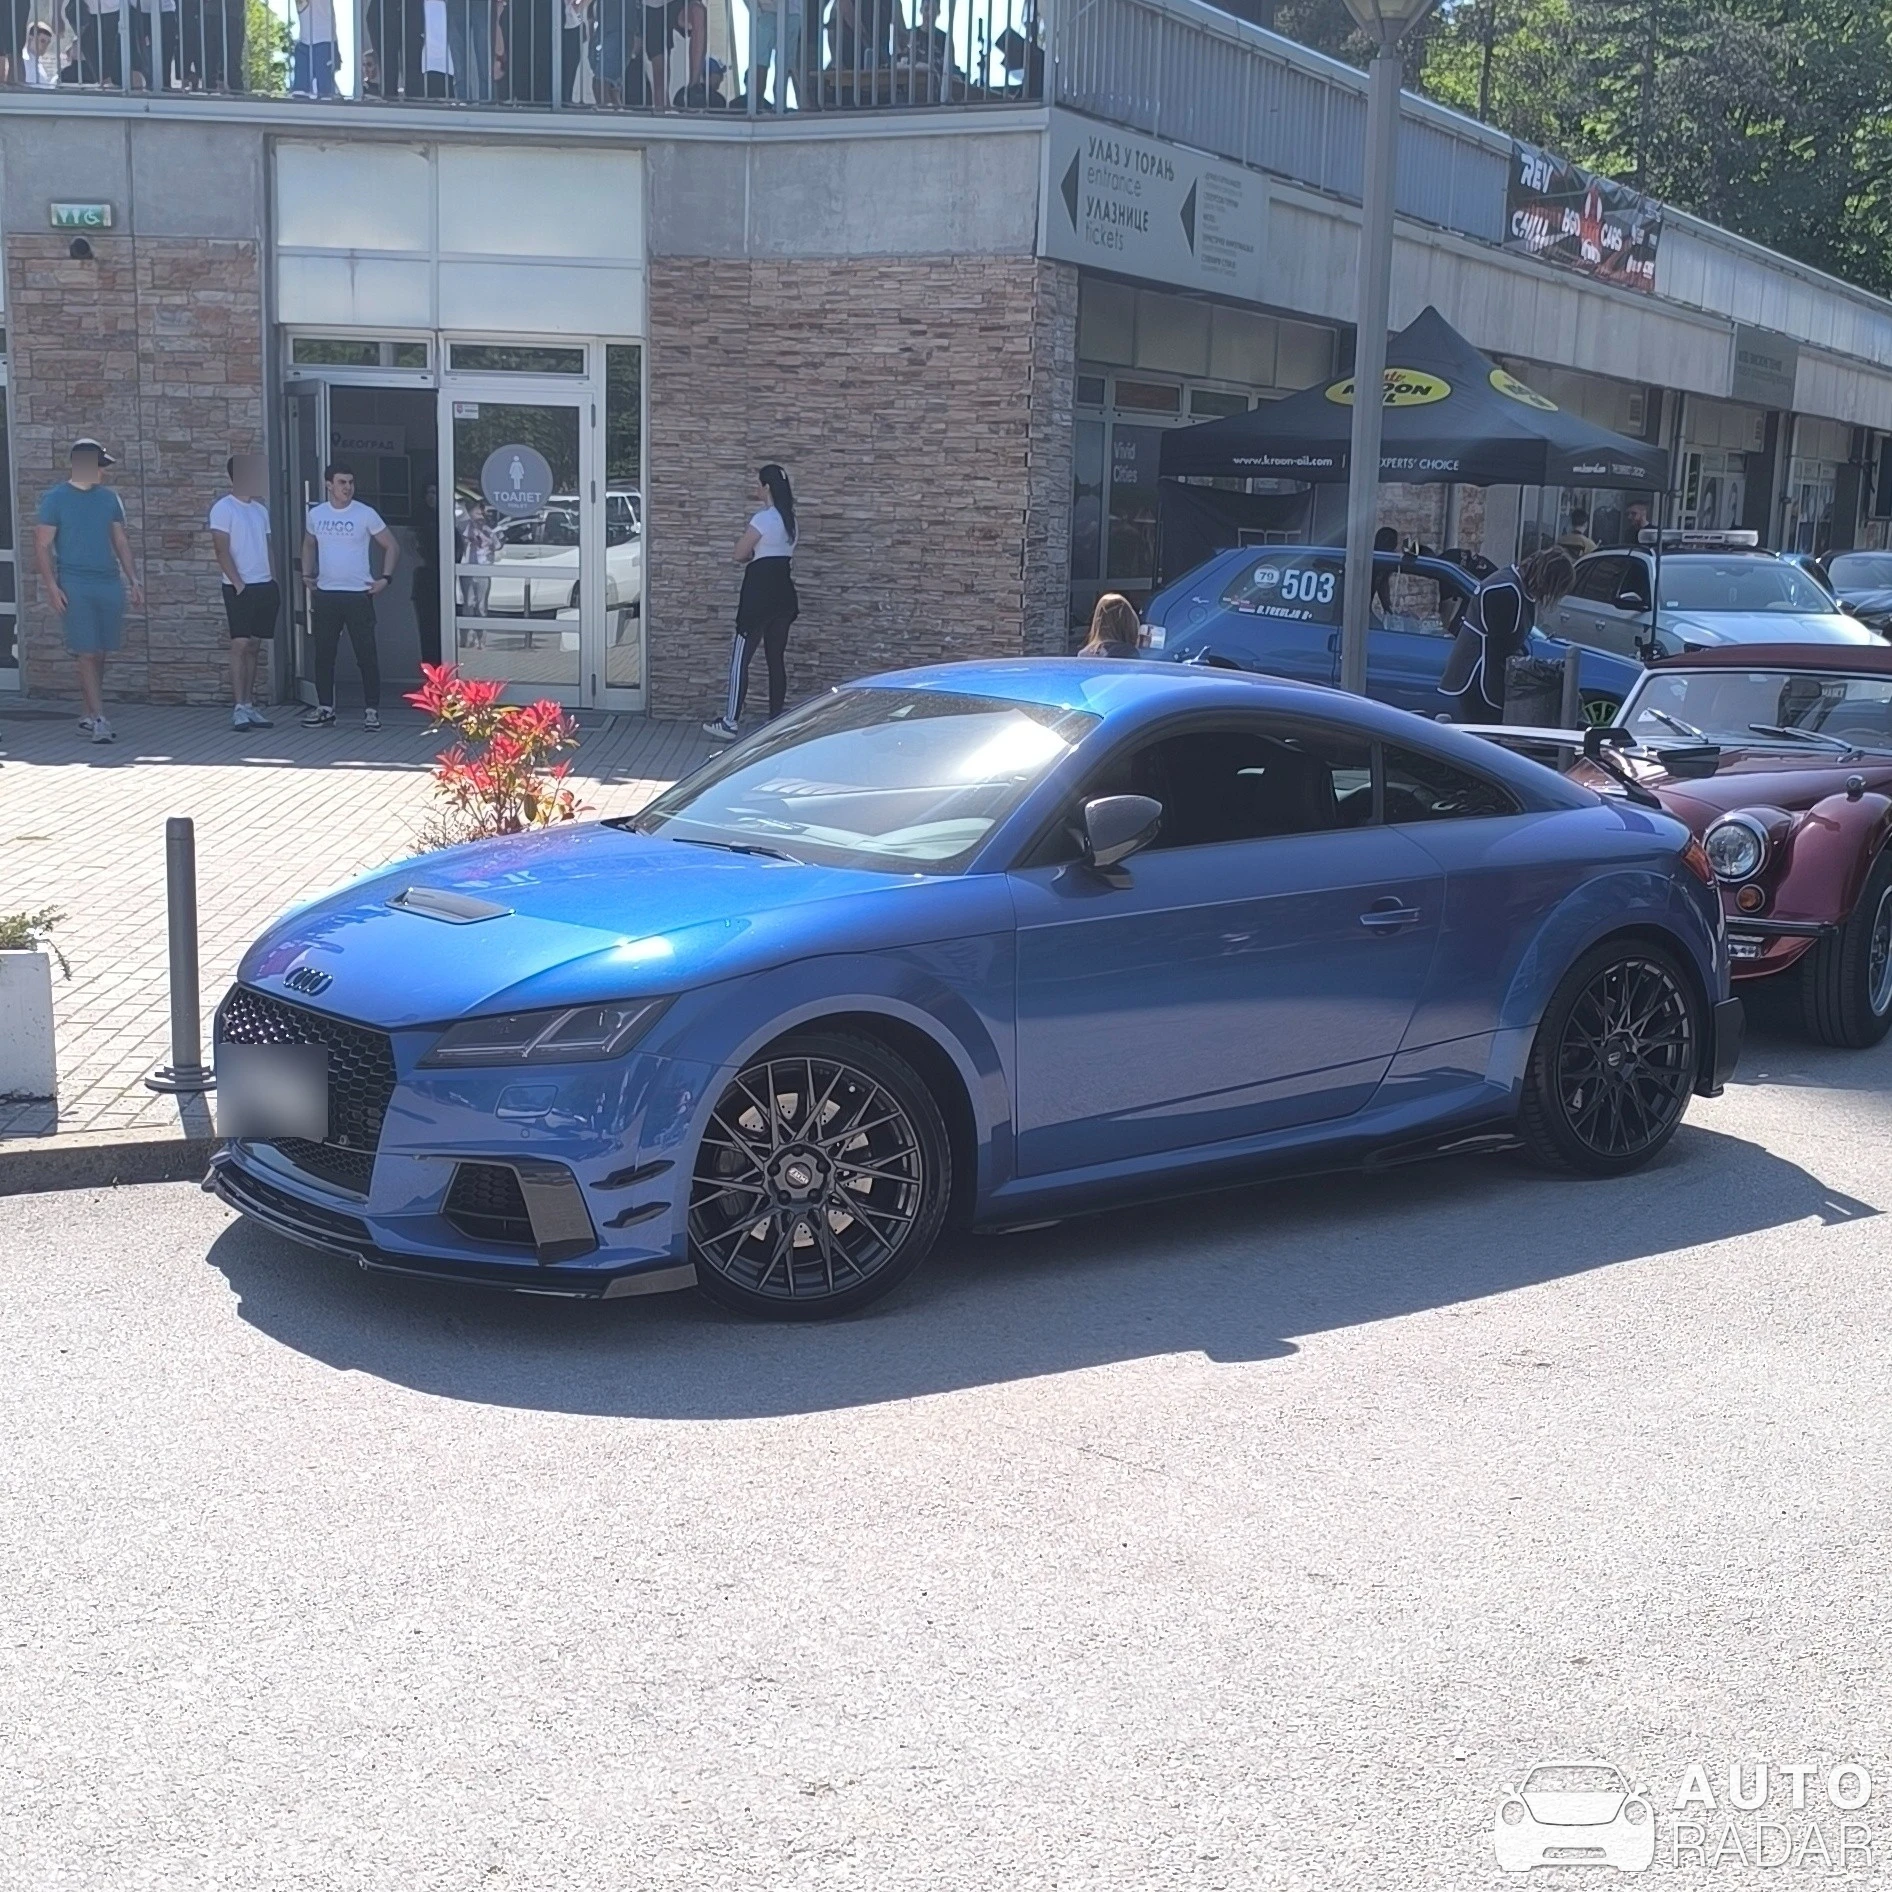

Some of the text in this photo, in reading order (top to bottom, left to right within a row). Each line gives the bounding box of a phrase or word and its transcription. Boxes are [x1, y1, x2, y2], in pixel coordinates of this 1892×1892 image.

[1088, 136, 1119, 166] УЛАЗ
[1124, 147, 1132, 168] У
[1135, 150, 1175, 181] ТОРАЊ
[1087, 166, 1142, 197] entrance
[1086, 195, 1149, 233] УЛАЗНИЦЕ
[1085, 221, 1124, 251] tickets
[1233, 454, 1333, 466] www.kroon-oil.com
[1380, 457, 1459, 471] XPERTS' CHOICE
[493, 491, 542, 503] ТОАЛЕТ
[318, 520, 354, 532] HUGO
[1259, 570, 1274, 581] 79
[1281, 568, 1336, 604] 503
